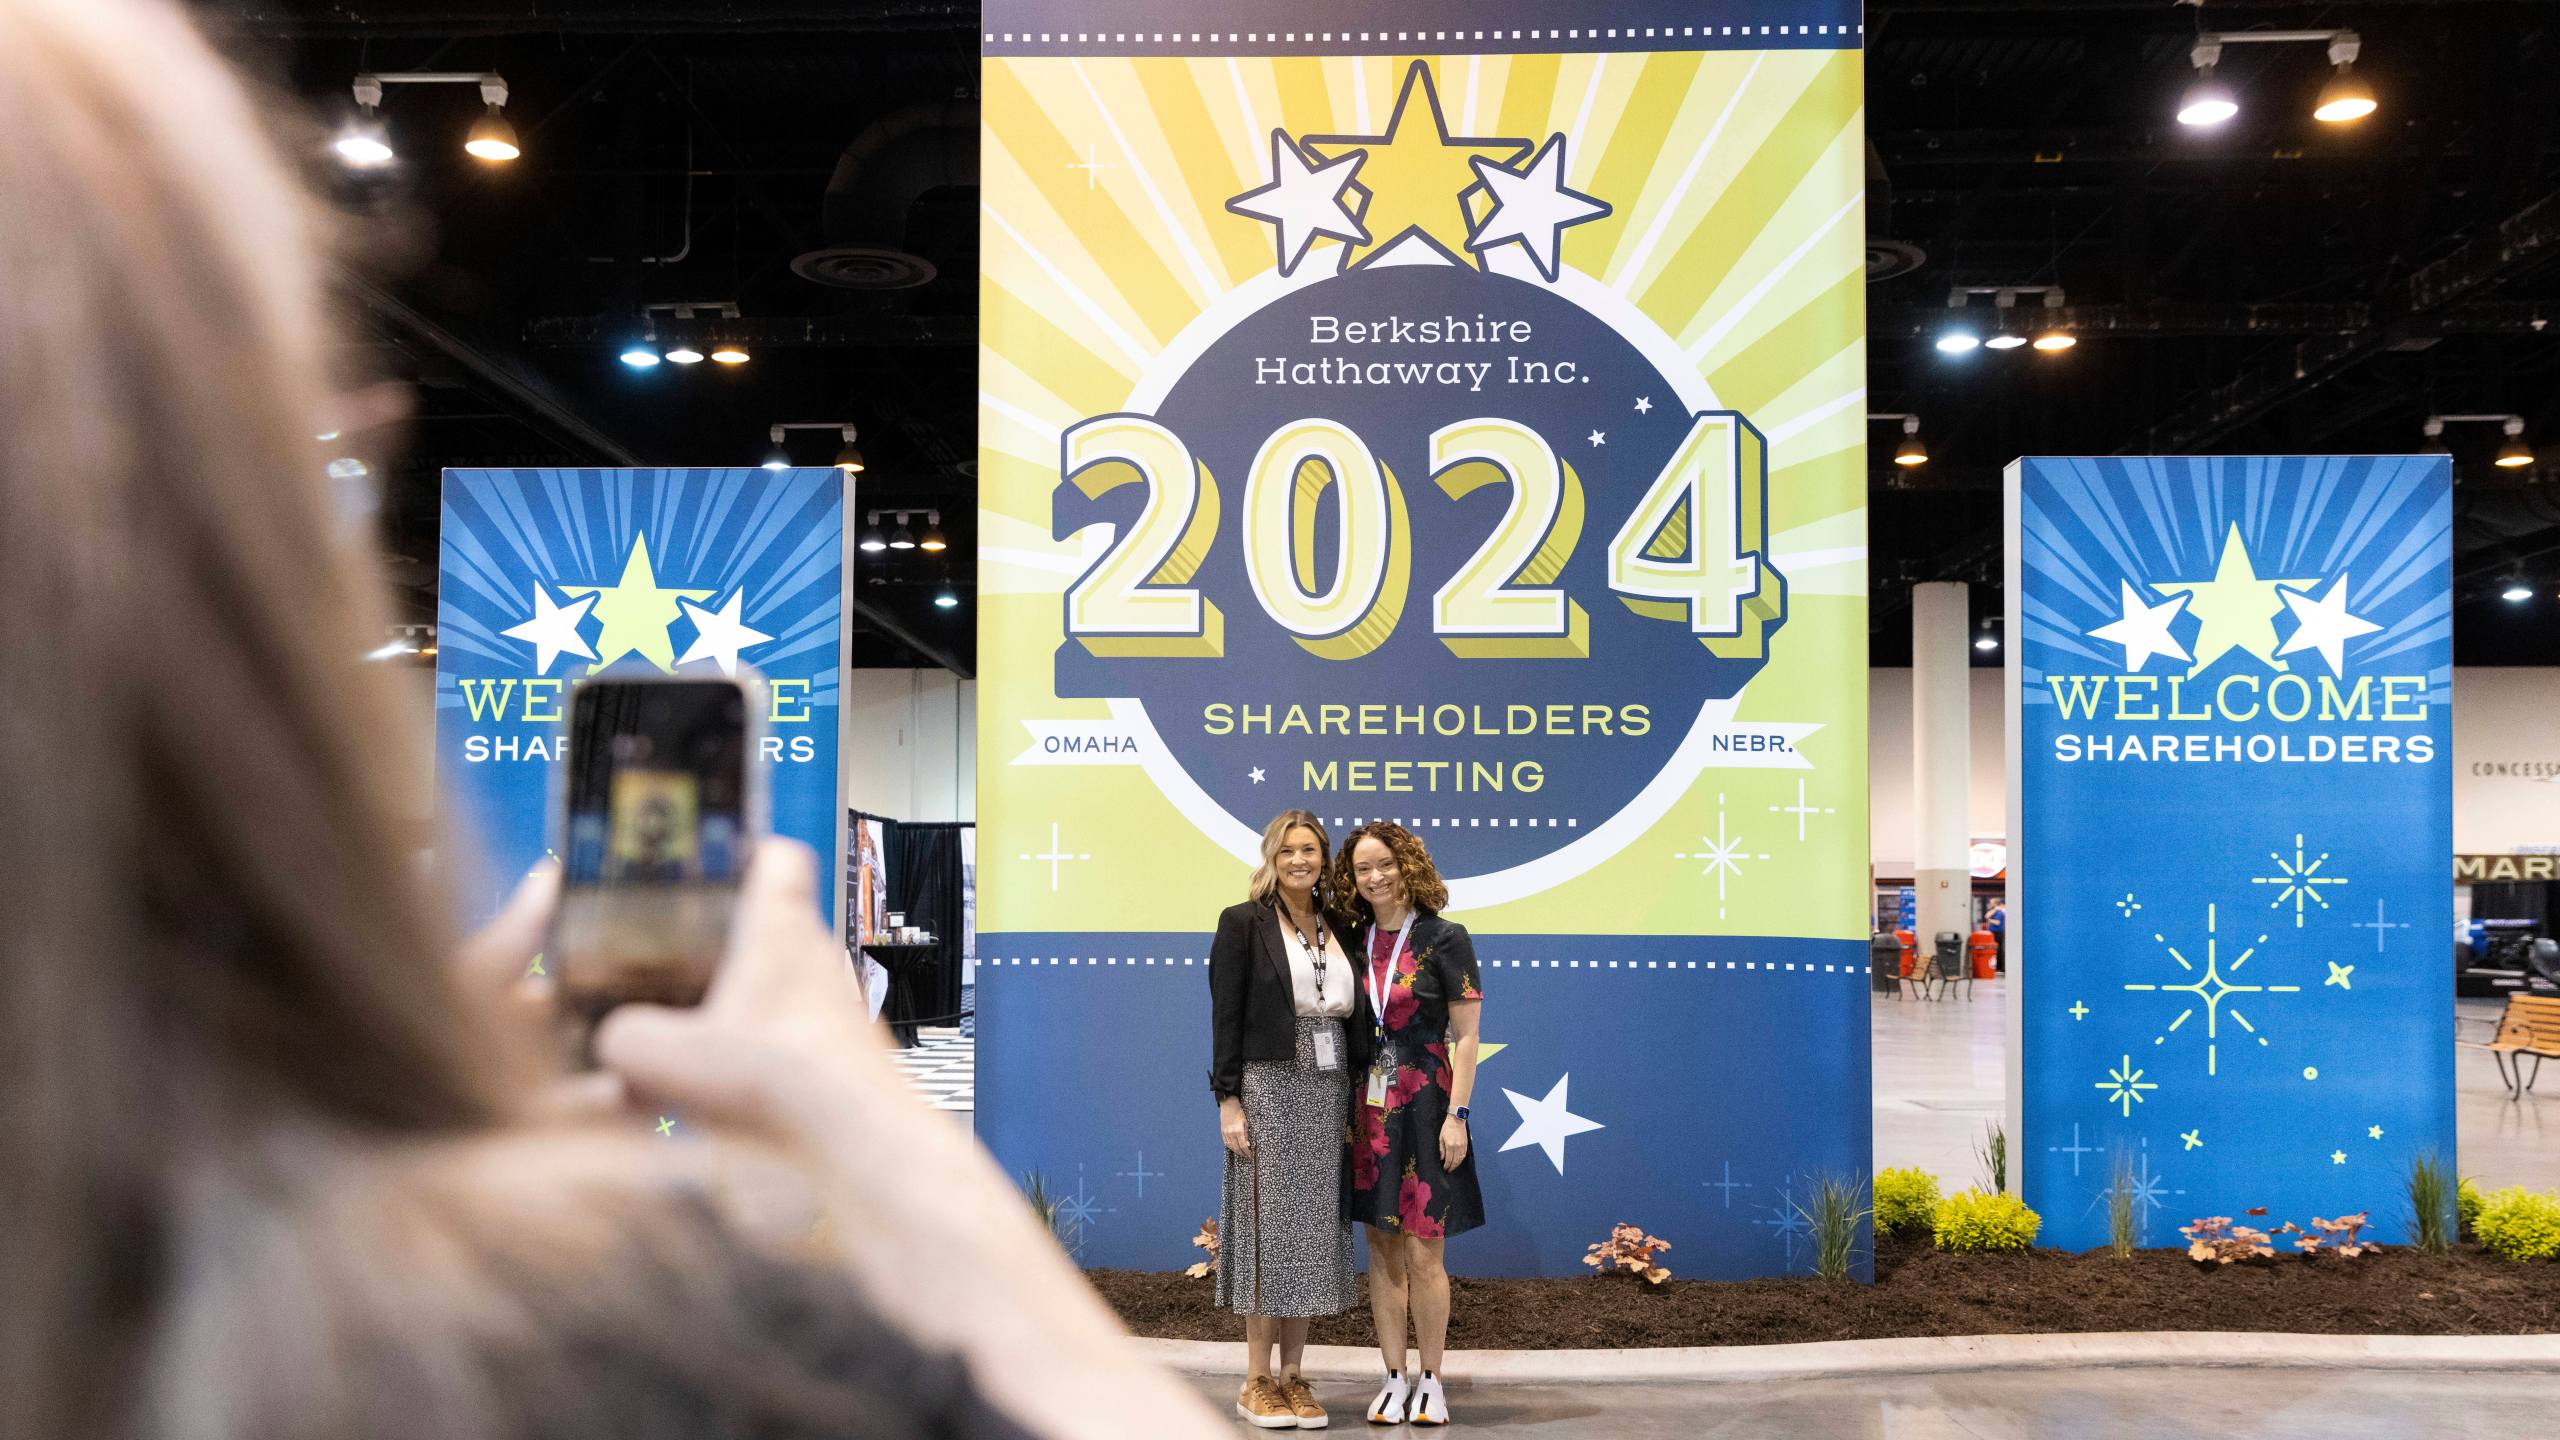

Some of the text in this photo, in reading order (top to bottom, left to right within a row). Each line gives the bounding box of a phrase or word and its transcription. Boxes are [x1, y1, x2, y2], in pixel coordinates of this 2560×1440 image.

[1309, 313, 1532, 344] Berkshire
[1254, 355, 1591, 392] Hathaway Inc.
[1062, 412, 1780, 658] 2024
[2045, 673, 2429, 722] WELCOME
[1203, 702, 1652, 736] SHAREHOLDERS
[1043, 735, 1139, 753] OMAHA
[1711, 733, 1794, 753] NEBR.
[2054, 733, 2435, 763] SHAREHOLDERS
[1302, 760, 1545, 793] MEETING
[2452, 856, 2560, 881] MAR
